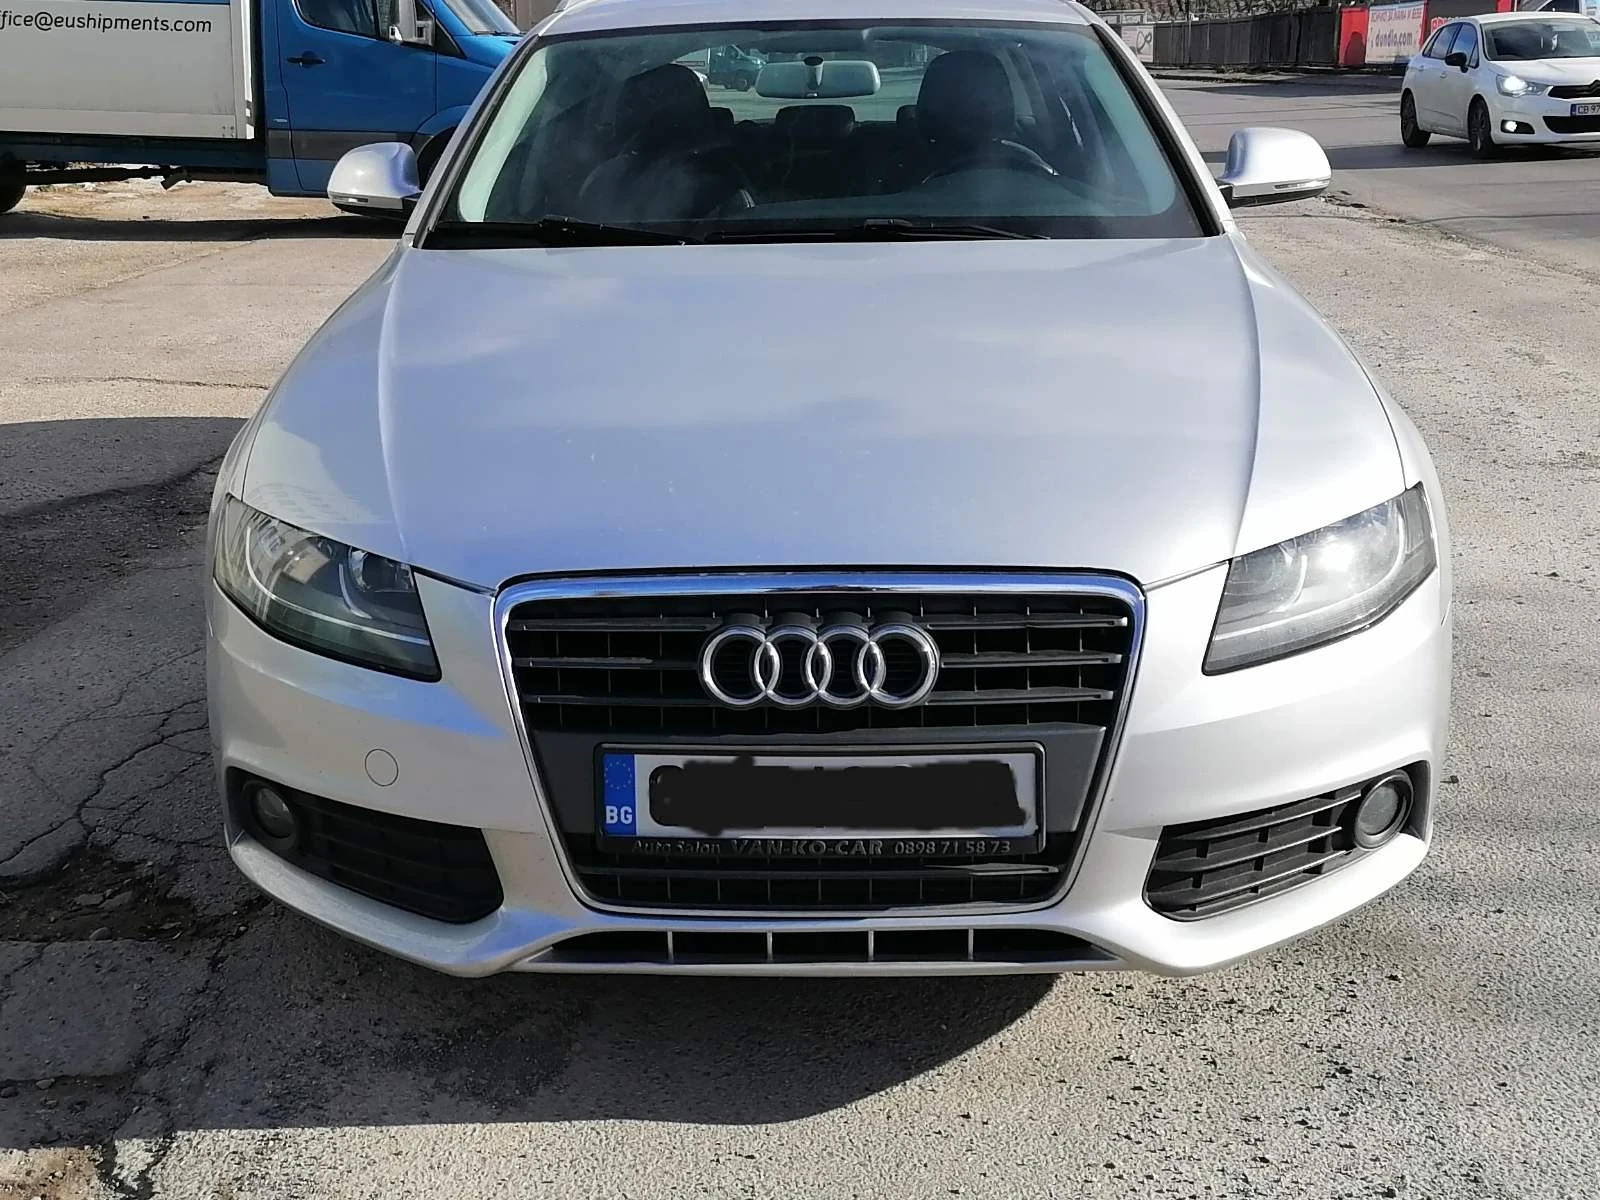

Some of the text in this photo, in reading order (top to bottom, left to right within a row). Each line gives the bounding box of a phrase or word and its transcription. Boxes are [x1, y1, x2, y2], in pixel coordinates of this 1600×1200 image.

[0, 10, 212, 33] fice@eushipments.com
[605, 805, 633, 825] BG
[632, 840, 1011, 856] Auto Salon VAN-KO-CAR 0898 71 58 73
